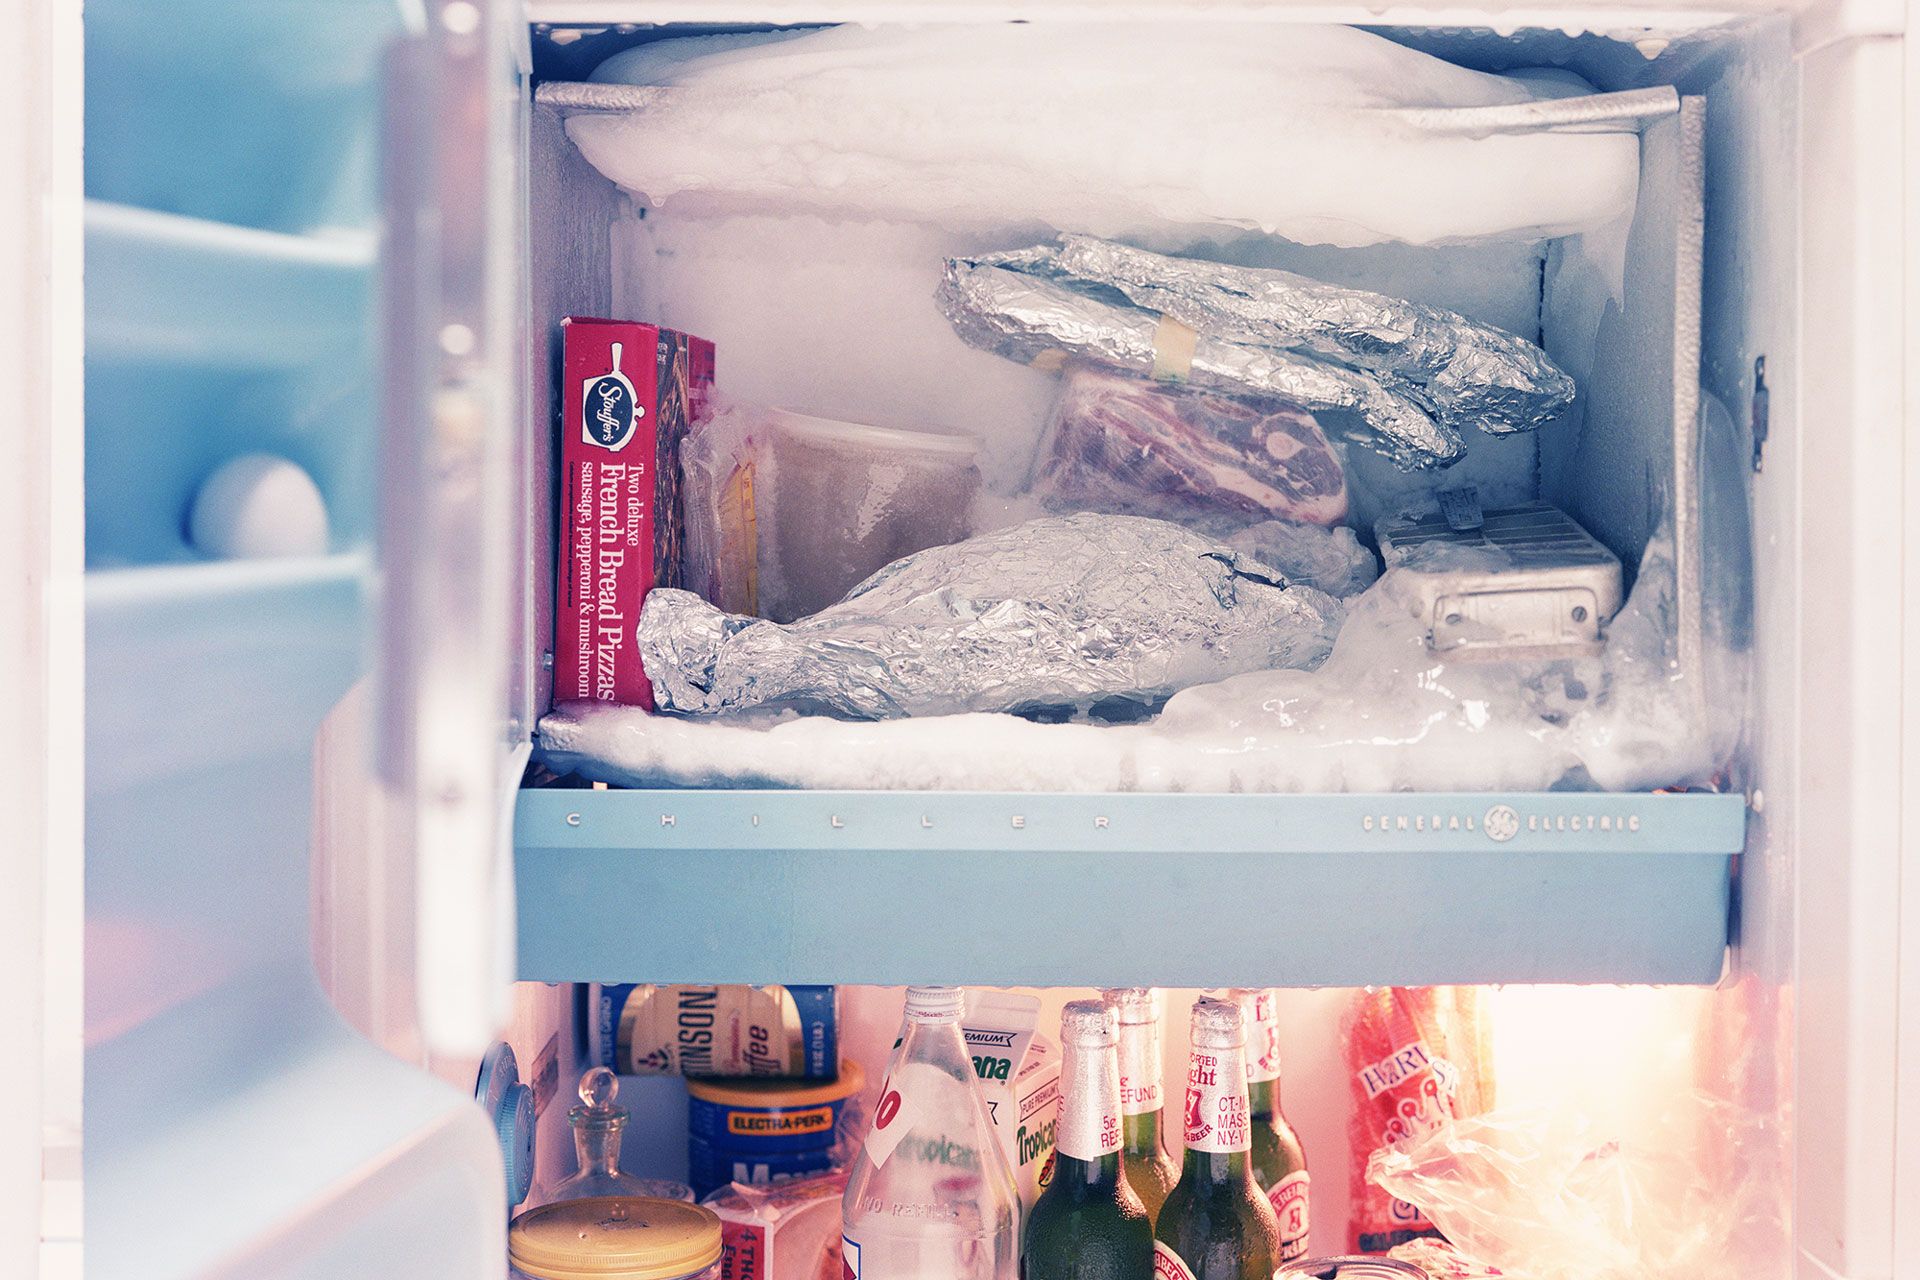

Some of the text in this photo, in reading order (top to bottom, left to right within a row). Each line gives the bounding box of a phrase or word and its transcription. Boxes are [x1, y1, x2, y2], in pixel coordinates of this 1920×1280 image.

[596, 381, 623, 443] Stouffer's
[626, 463, 644, 546] Two deluxe
[576, 461, 595, 698] sausage, pepperoni & mushroom
[596, 462, 626, 700] French Bread Pizzas
[1362, 815, 1475, 831] GENERAL
[1527, 815, 1641, 831] ELECTRIC
[1187, 1065, 1217, 1086] ght
